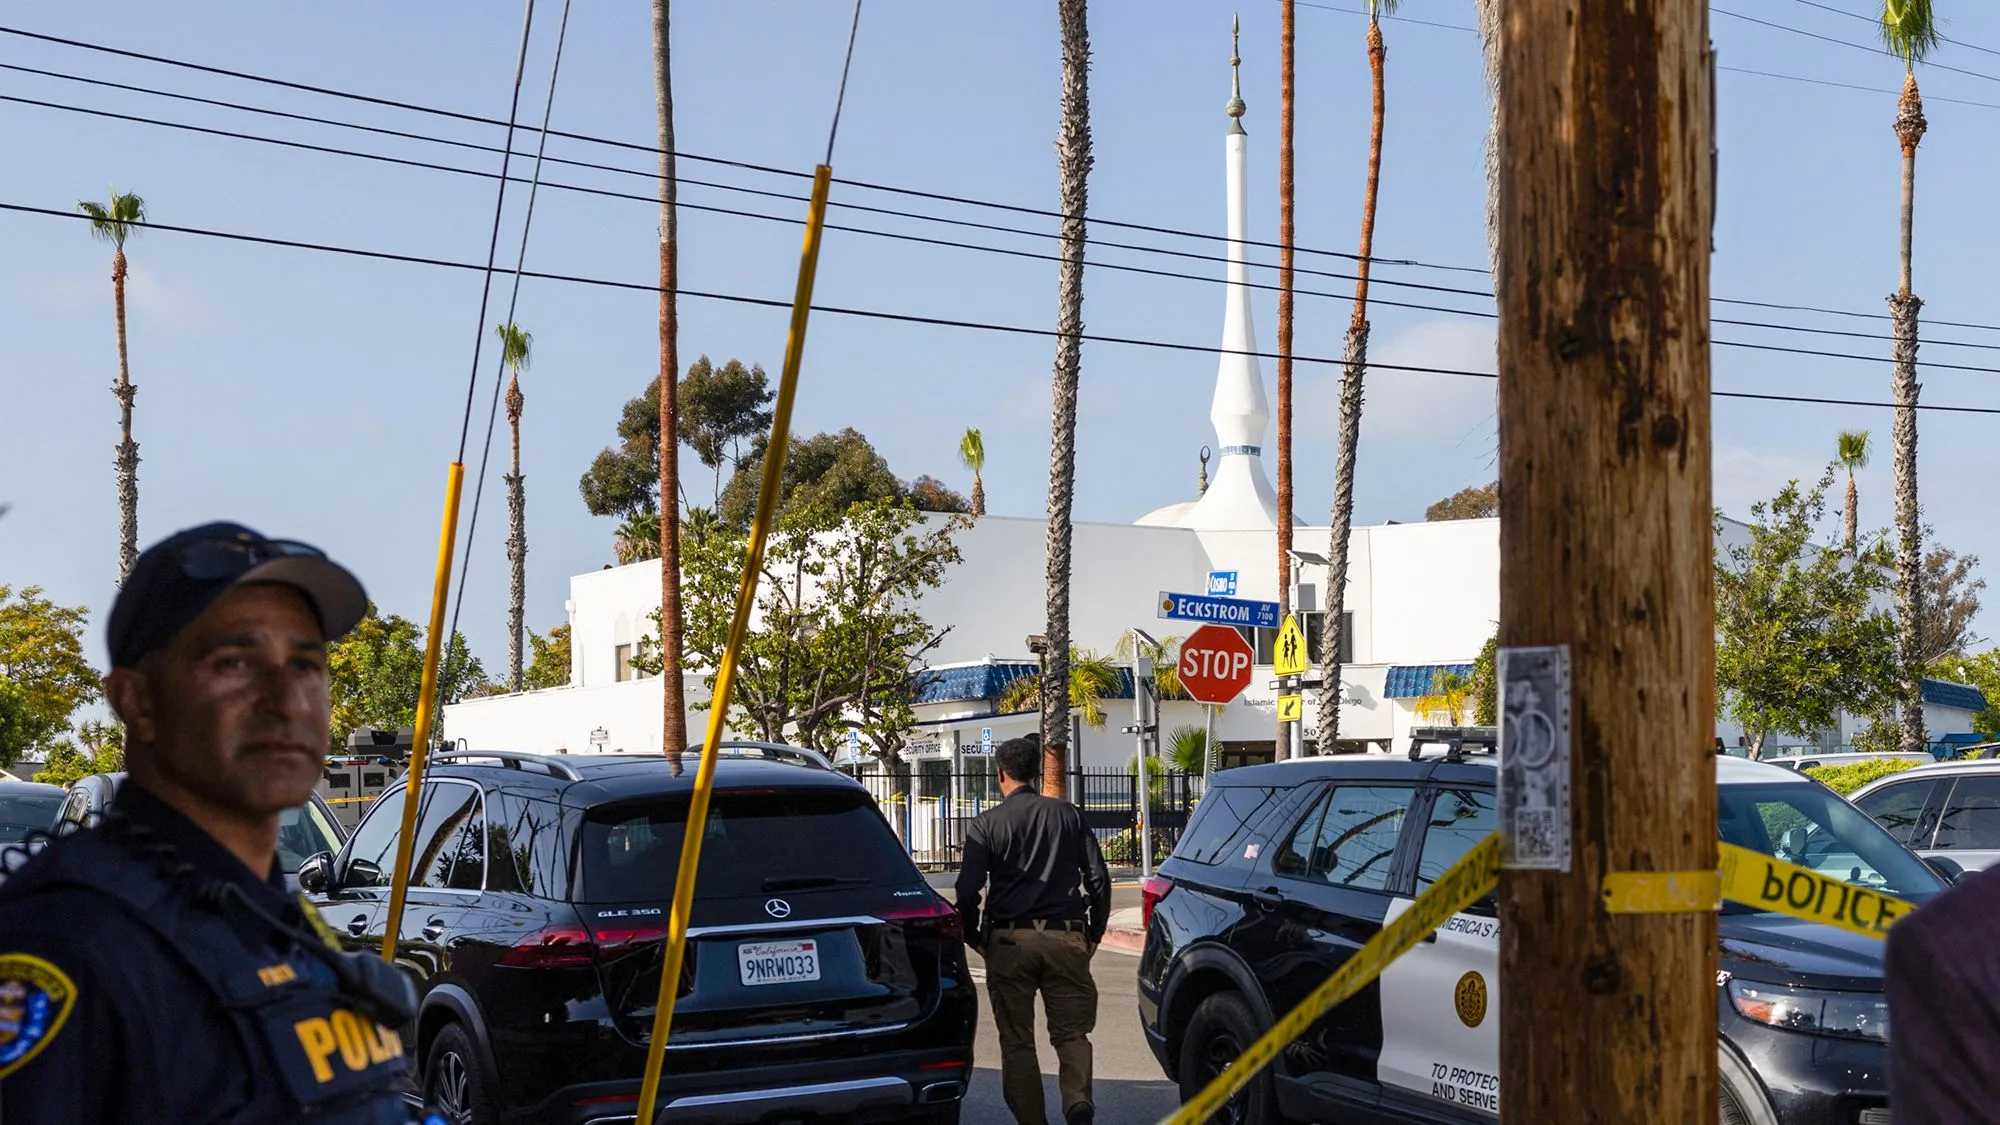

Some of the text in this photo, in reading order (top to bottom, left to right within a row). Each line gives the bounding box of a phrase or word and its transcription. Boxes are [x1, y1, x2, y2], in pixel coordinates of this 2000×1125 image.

[1178, 598, 1250, 621] ECKSTROM
[1261, 604, 1271, 612] AV
[1183, 648, 1249, 680] STOP
[598, 908, 661, 918] GLE 350
[1438, 916, 1493, 937] MERICA'S
[755, 945, 799, 957] California
[746, 955, 815, 980] 9NRW033
[1431, 1062, 1499, 1091] TO PROTEC
[1432, 1081, 1498, 1111] AND SERVE
